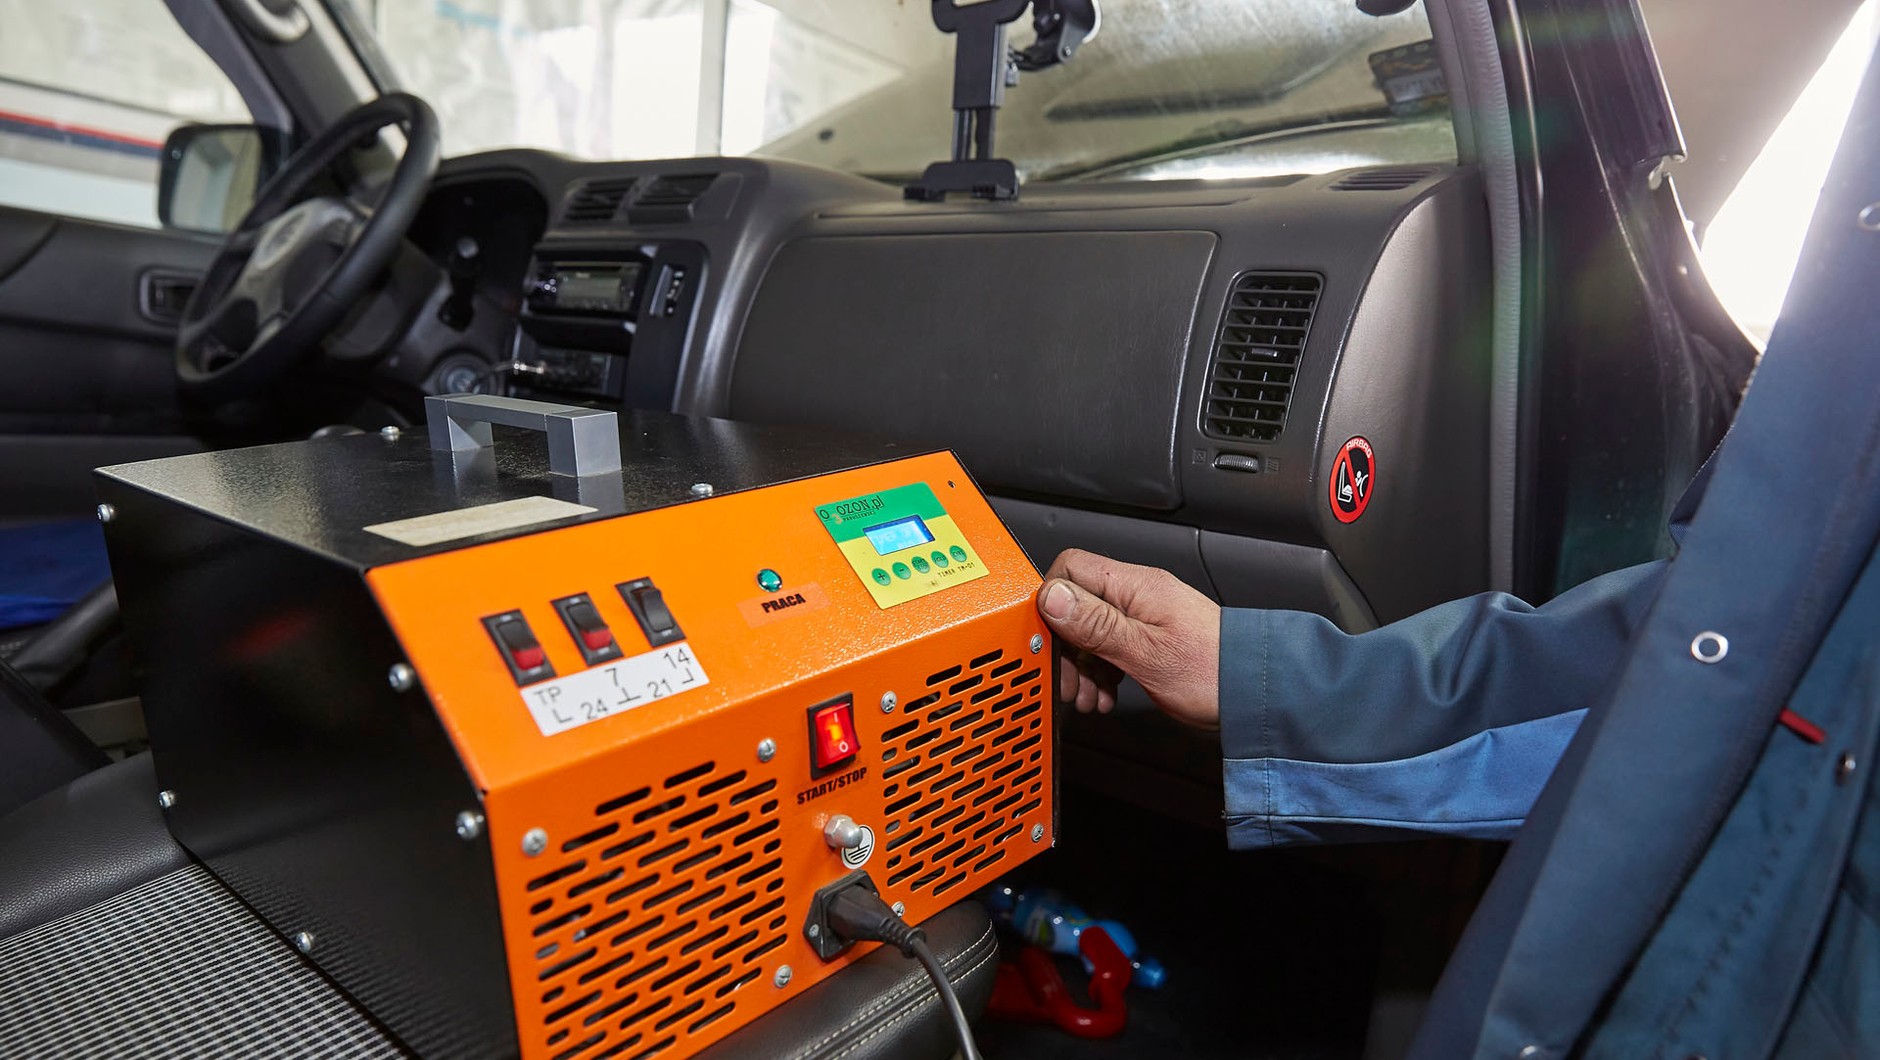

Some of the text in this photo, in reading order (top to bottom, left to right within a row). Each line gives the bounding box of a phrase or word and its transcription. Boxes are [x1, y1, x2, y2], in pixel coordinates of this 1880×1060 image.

[1346, 438, 1373, 459] AIRBAG
[761, 593, 806, 613] PRACA
[664, 648, 690, 669] 14
[605, 667, 620, 687] 7
[533, 686, 561, 705] TP
[647, 678, 673, 698] 21
[580, 698, 609, 720] 24
[797, 767, 867, 805] START/STOP
